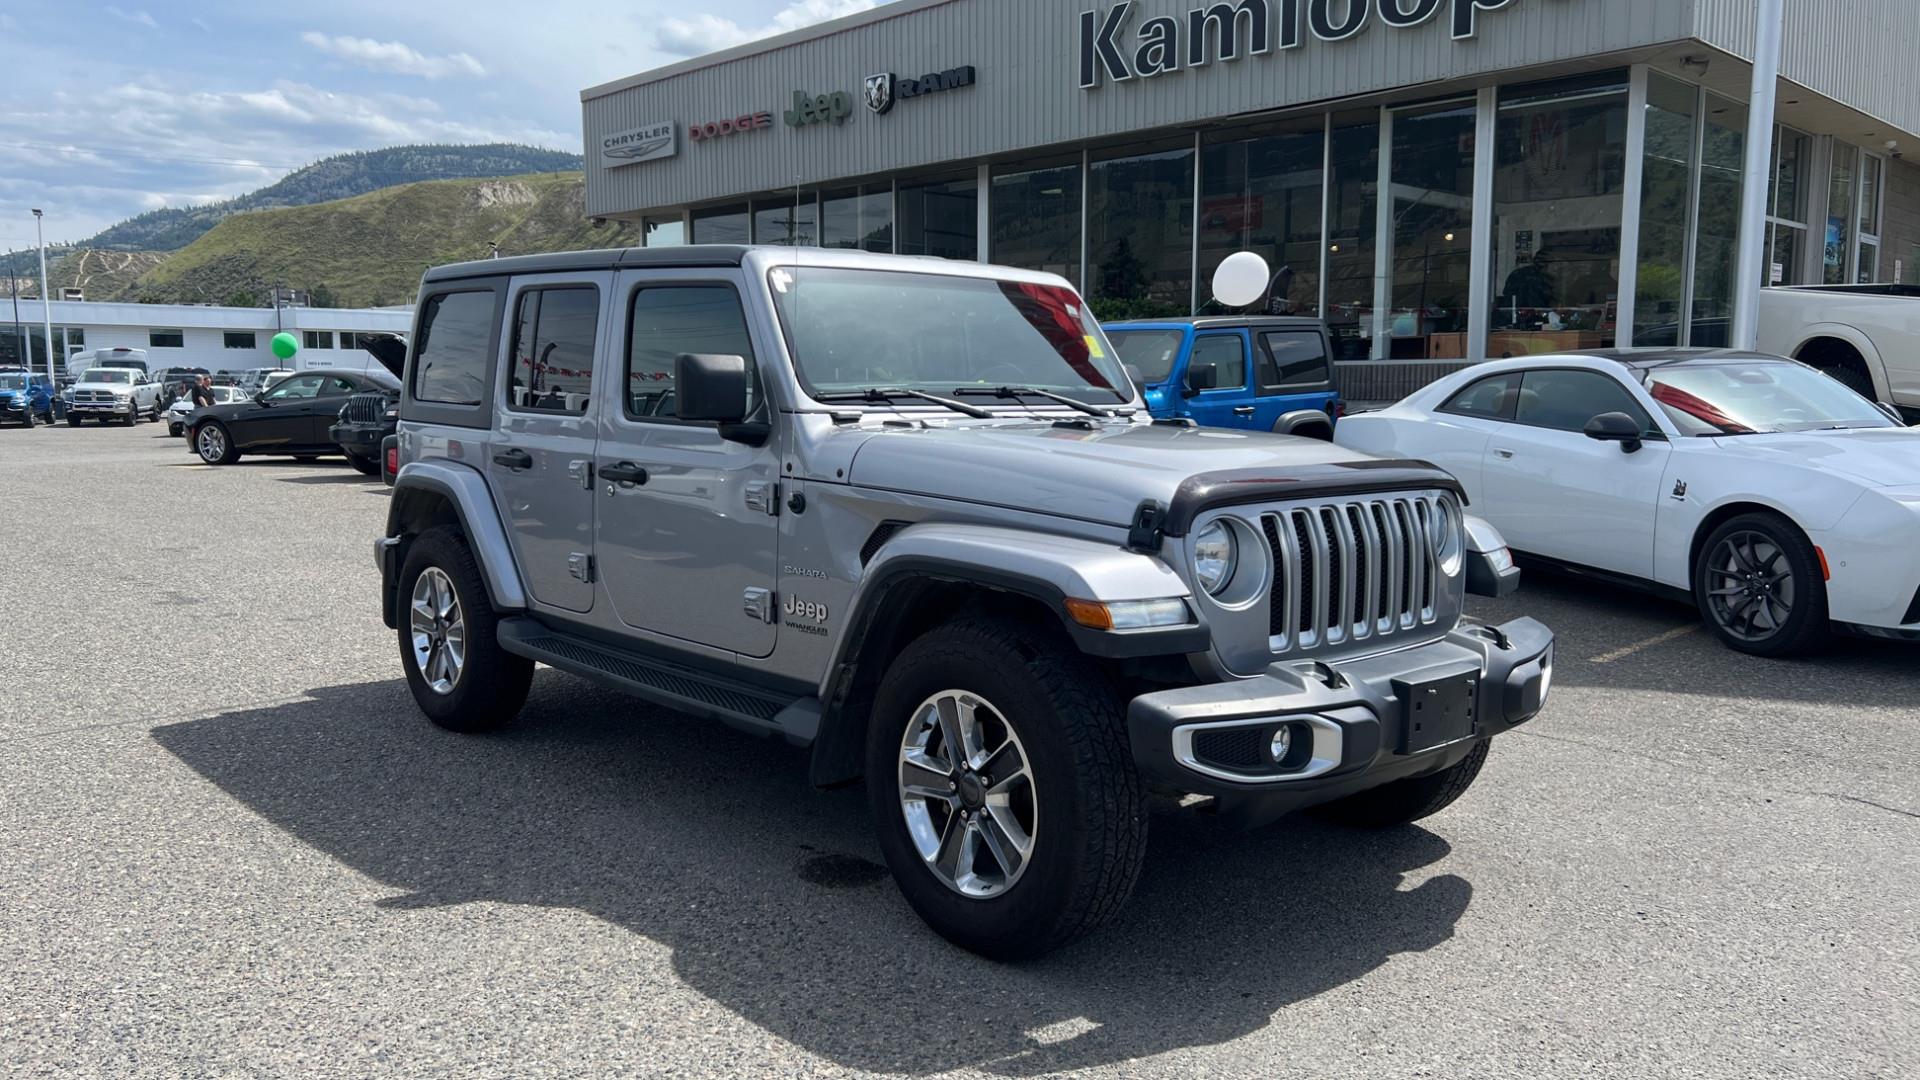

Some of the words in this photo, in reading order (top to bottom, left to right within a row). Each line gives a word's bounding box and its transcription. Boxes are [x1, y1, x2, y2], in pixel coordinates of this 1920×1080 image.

[896, 65, 976, 99] RAM
[783, 90, 851, 127] Jeep
[603, 126, 670, 148] CHRYSLER
[689, 112, 772, 142] DODGE
[784, 565, 828, 579] SAHARA
[784, 593, 828, 624] Jeep
